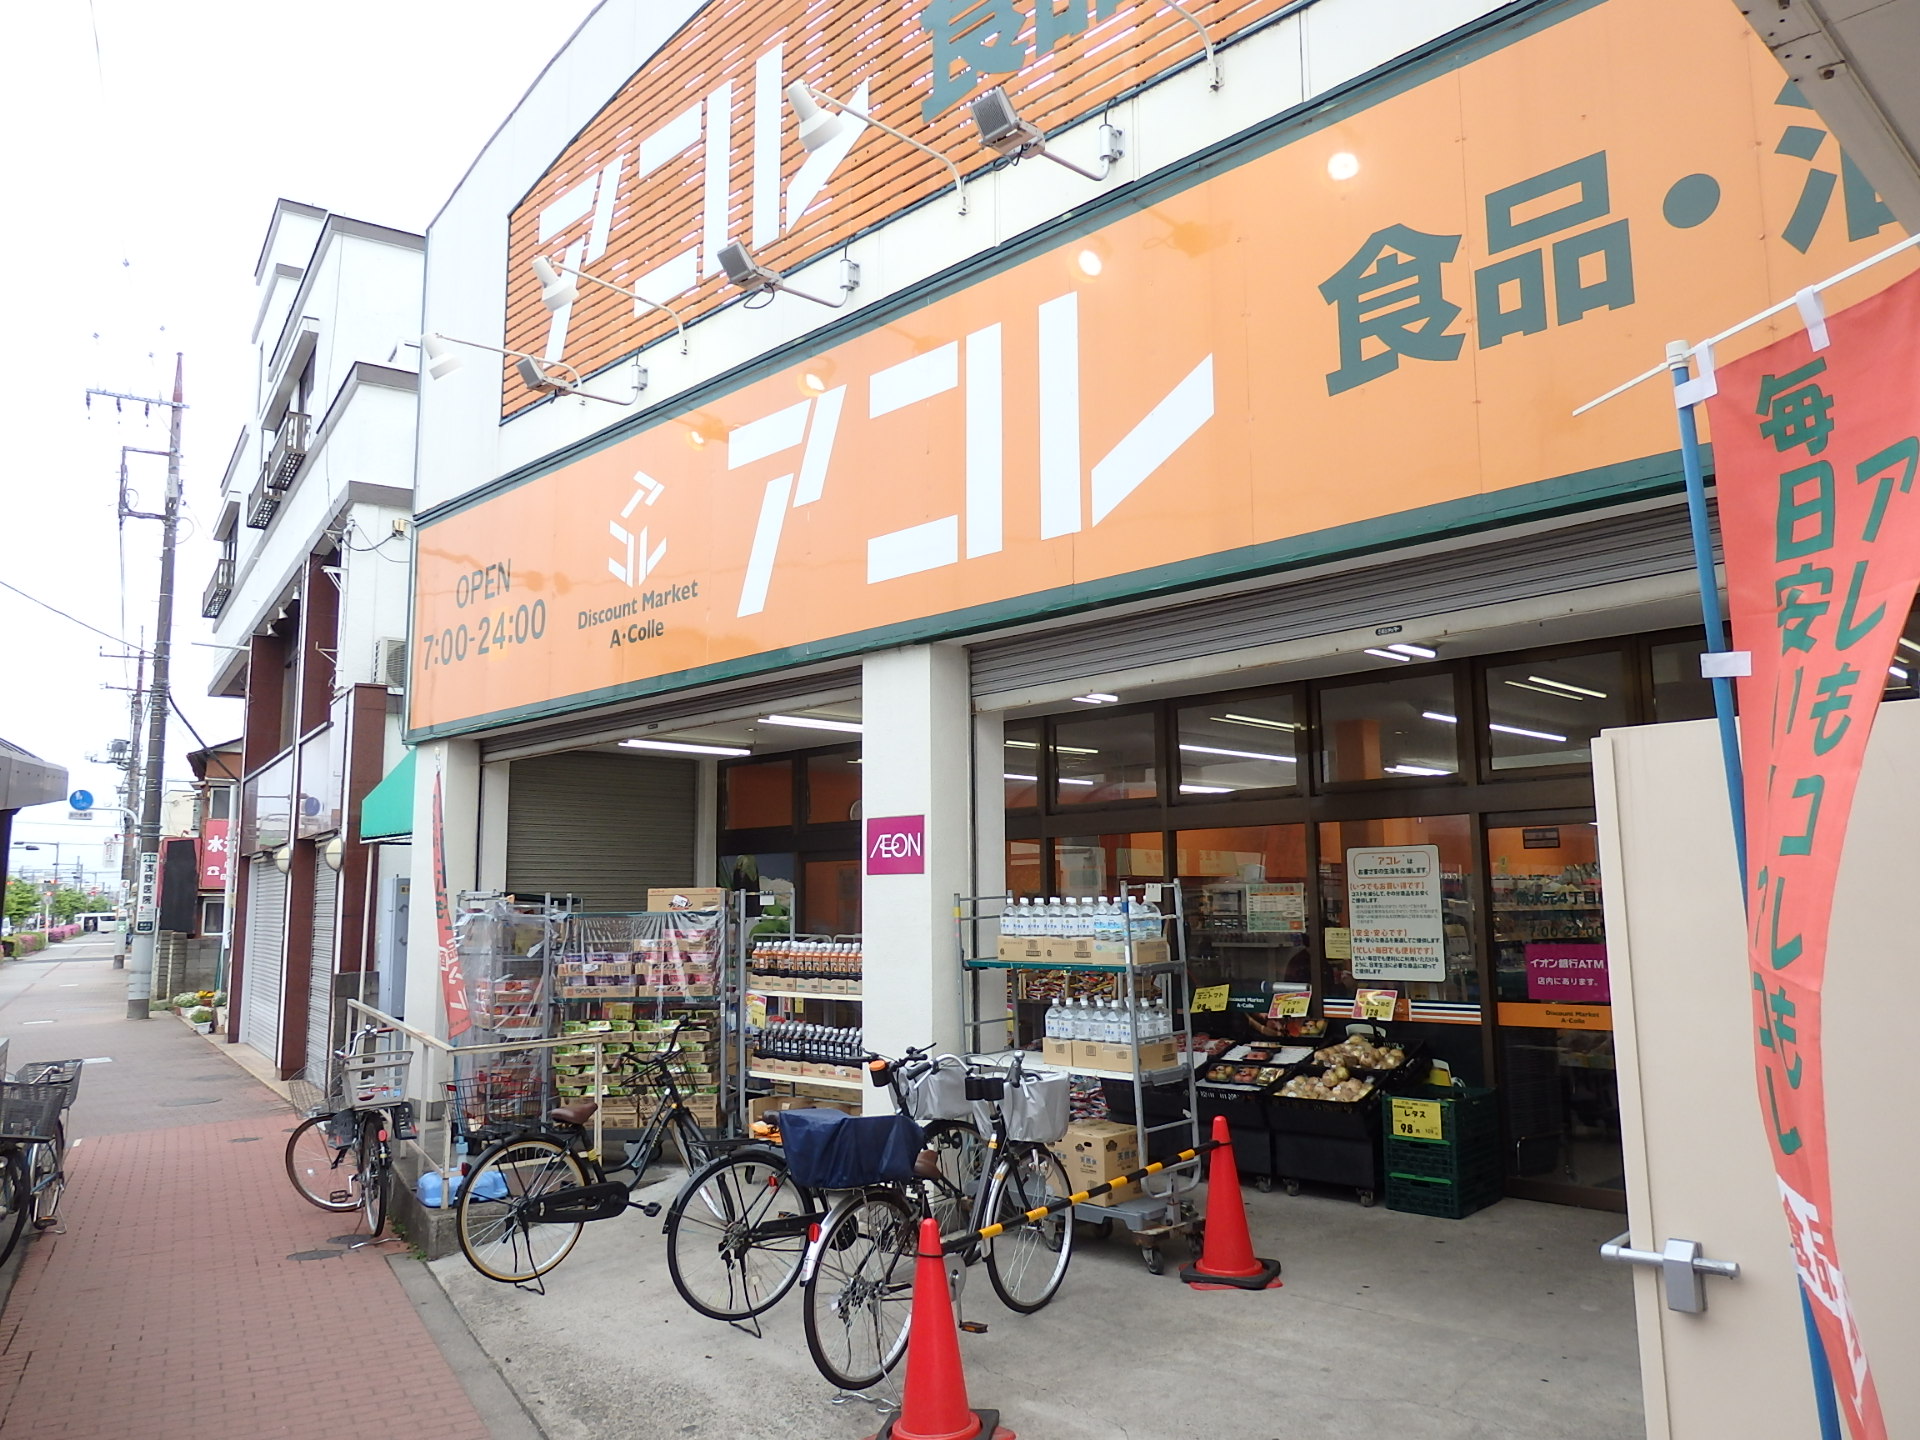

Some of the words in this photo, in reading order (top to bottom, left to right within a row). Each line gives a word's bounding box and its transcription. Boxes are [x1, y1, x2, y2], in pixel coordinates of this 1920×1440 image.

[538, 41, 869, 367] アコレ
[727, 290, 1215, 618] アコレ
[456, 558, 511, 608] OPEN
[577, 598, 638, 630] Discount
[641, 579, 699, 612] Market
[423, 598, 546, 670] 7:00-24:00
[1530, 958, 1604, 969] イオン銀行ATM
[1537, 976, 1598, 986] 店内にあります。
[1400, 1123, 1413, 1134] 98
[1404, 1110, 1426, 1118] レタス
